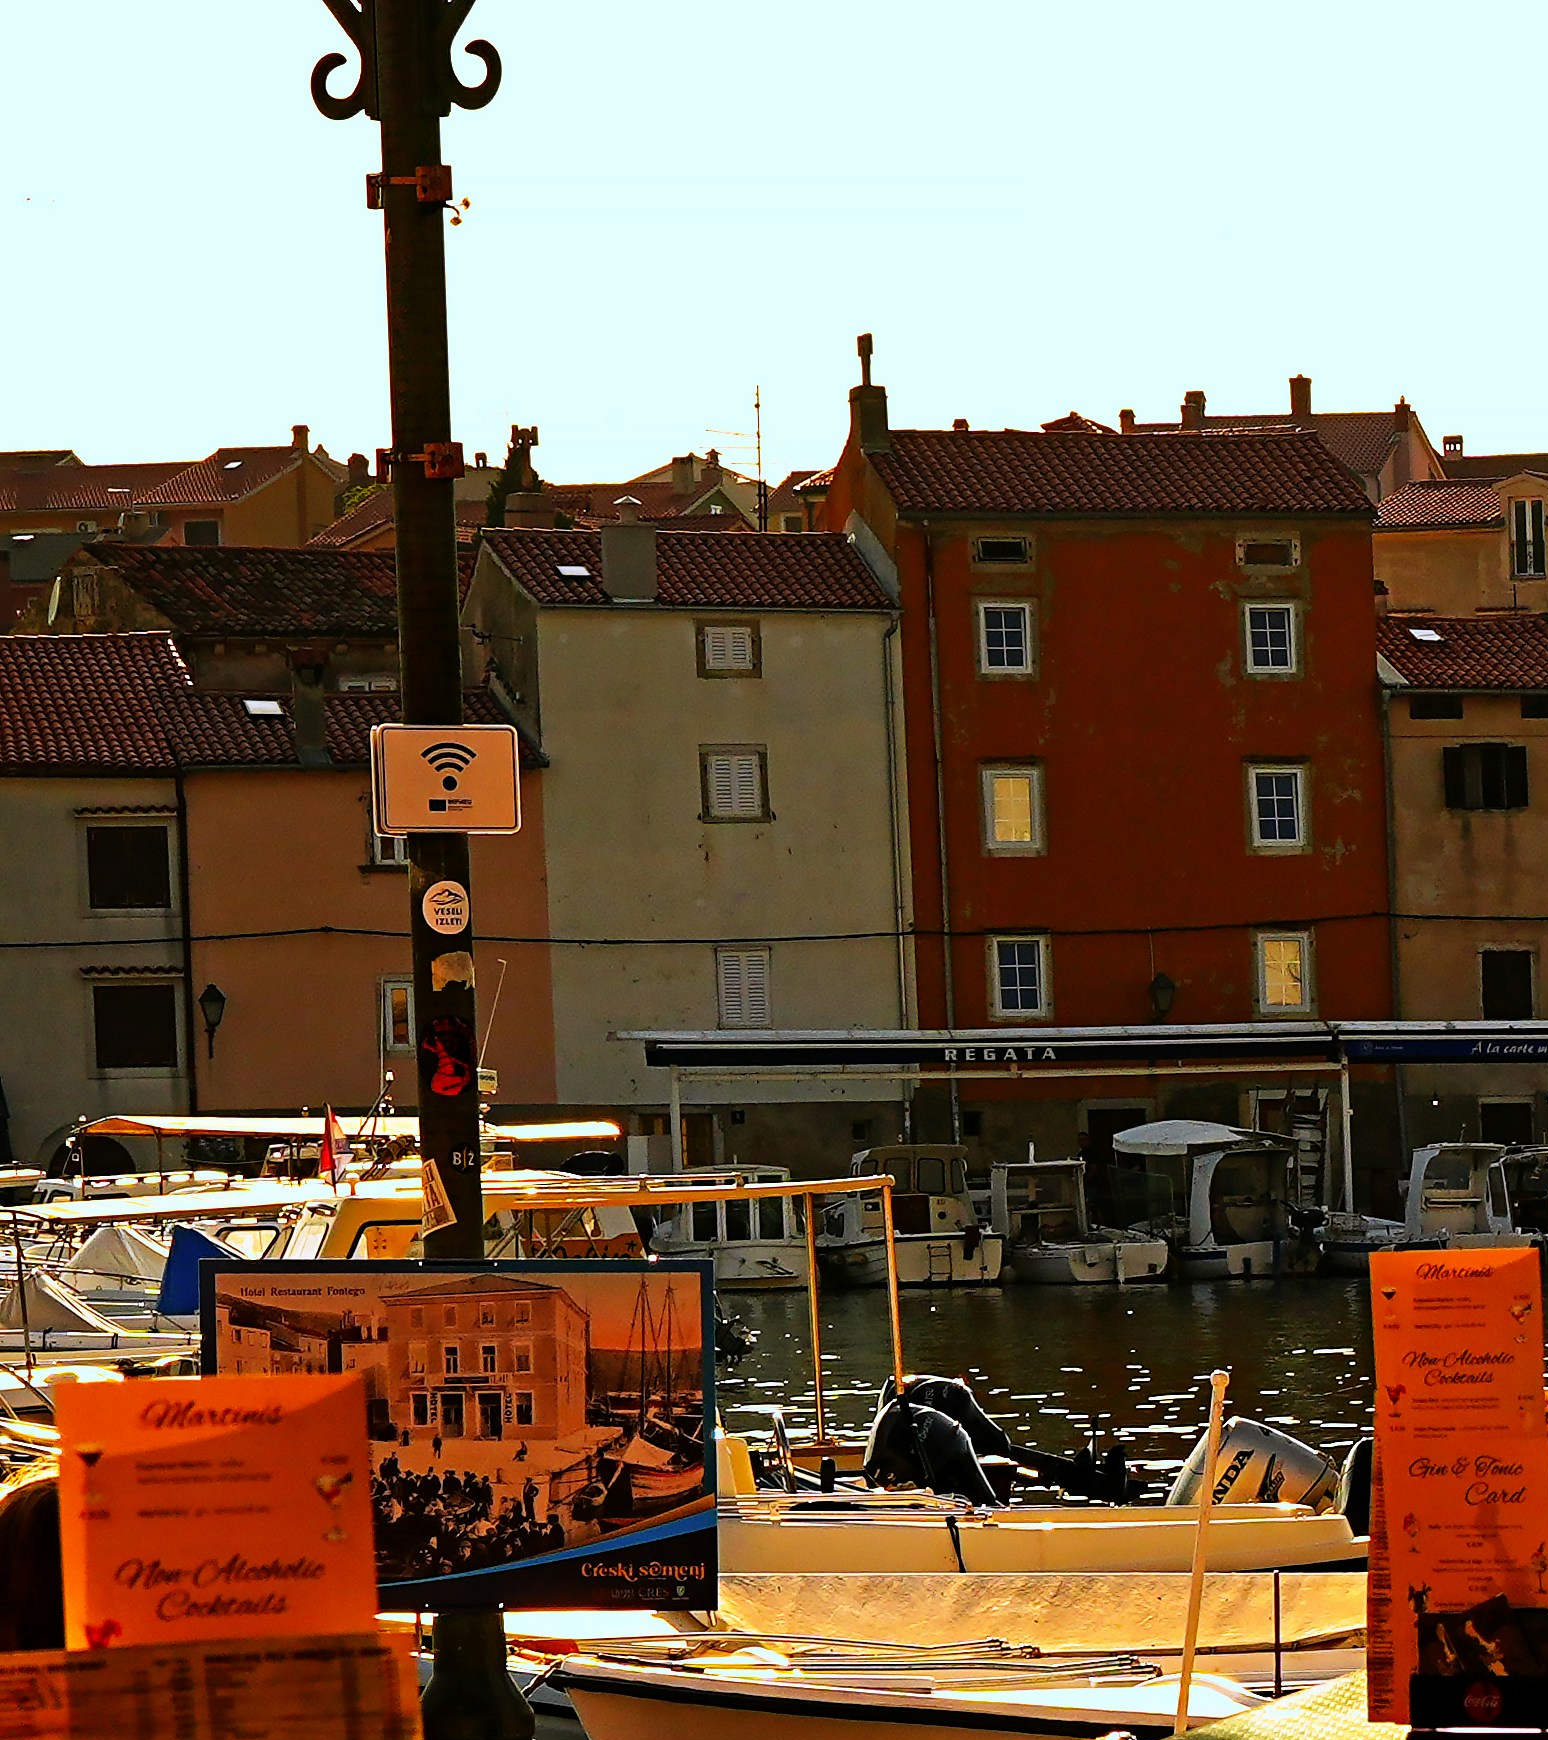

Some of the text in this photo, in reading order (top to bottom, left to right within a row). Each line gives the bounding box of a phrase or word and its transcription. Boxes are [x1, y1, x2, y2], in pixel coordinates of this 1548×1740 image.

[944, 1048, 1056, 1061] REGATA
[1503, 1042, 1533, 1054] carte
[1416, 1263, 1494, 1280] Martinis
[240, 1287, 265, 1296] Hotel
[271, 1287, 322, 1296] Restaurant
[1402, 1350, 1515, 1369] Non-Alcoholic
[1424, 1370, 1495, 1386] Cocktails
[140, 1400, 283, 1428] Martinis
[430, 1392, 438, 1423] HOTEL
[504, 1392, 513, 1424] HOTEL
[1408, 1457, 1448, 1479] Gin
[1474, 1455, 1524, 1478] Tonic
[1464, 1482, 1527, 1506] Card
[156, 1590, 288, 1622] Cocktails
